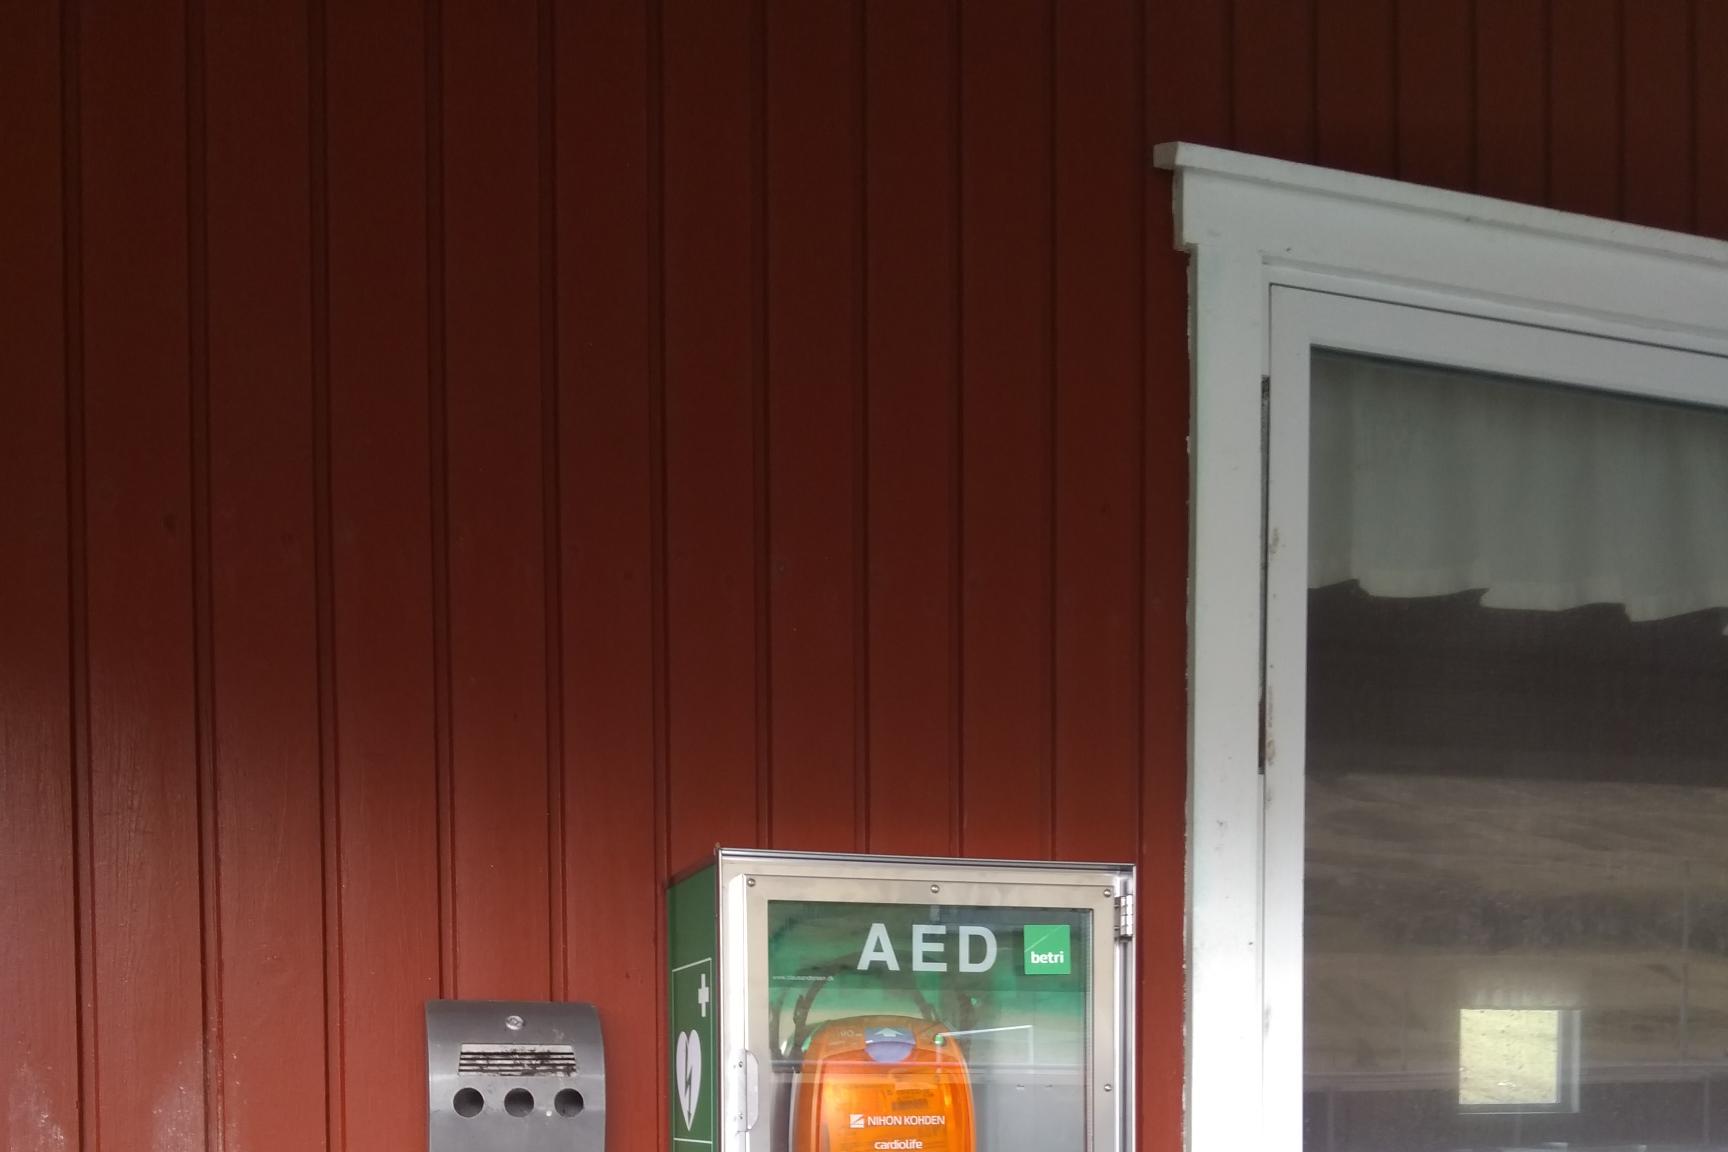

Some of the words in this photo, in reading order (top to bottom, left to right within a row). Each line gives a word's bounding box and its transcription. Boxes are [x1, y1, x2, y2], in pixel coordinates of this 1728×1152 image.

[857, 923, 997, 972] AED
[1031, 950, 1065, 964] betri
[868, 1115, 902, 1125] NIHON
[903, 1115, 945, 1125] KOHDEN
[874, 1139, 923, 1149] cardiolife
